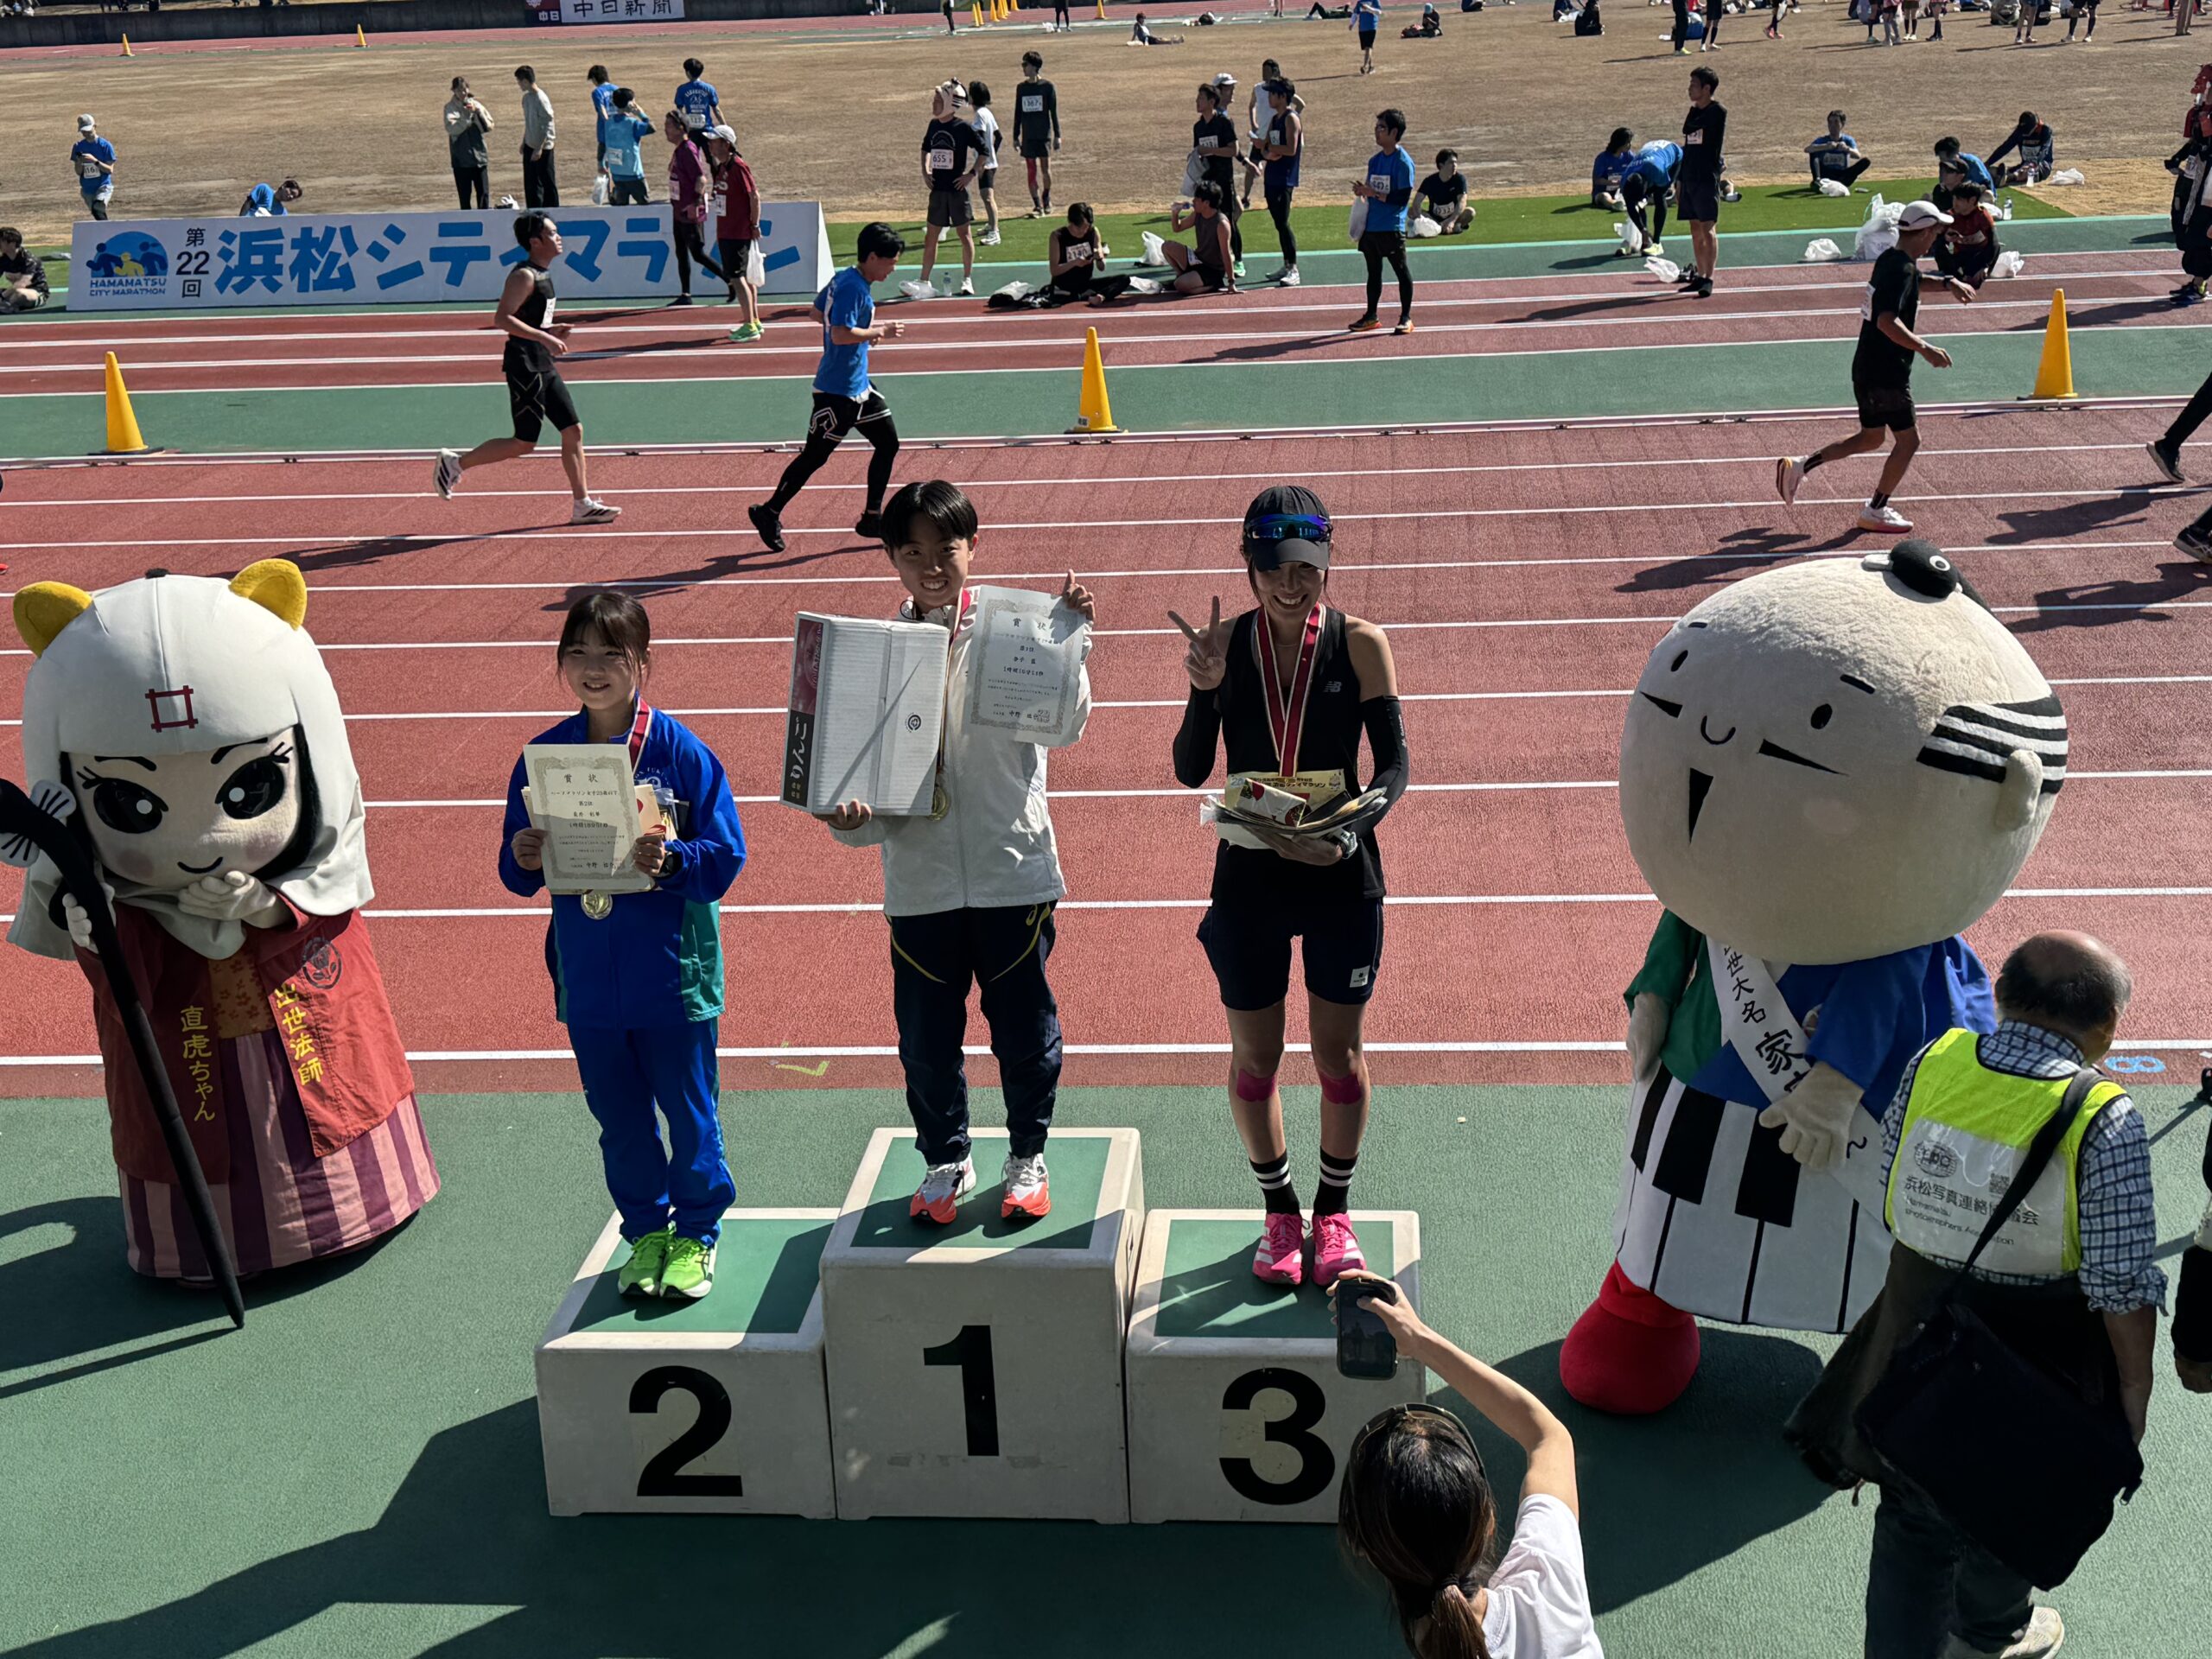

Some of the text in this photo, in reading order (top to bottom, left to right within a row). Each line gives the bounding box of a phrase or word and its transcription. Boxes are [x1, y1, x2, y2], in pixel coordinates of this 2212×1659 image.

[538, 10, 560, 22] 中日
[573, 0, 672, 18] 中日新聞
[89, 277, 168, 289] HAMAMATSU
[89, 287, 166, 297] CITY MARATHON
[180, 1005, 216, 1122] 直虎ちゃん
[273, 982, 325, 1086] 出世法師
[1904, 1173, 2039, 1226] 浜松写真連絡会
[922, 1324, 1001, 1457] 1
[627, 1364, 744, 1497] 2
[1217, 1366, 1337, 1506] 3
